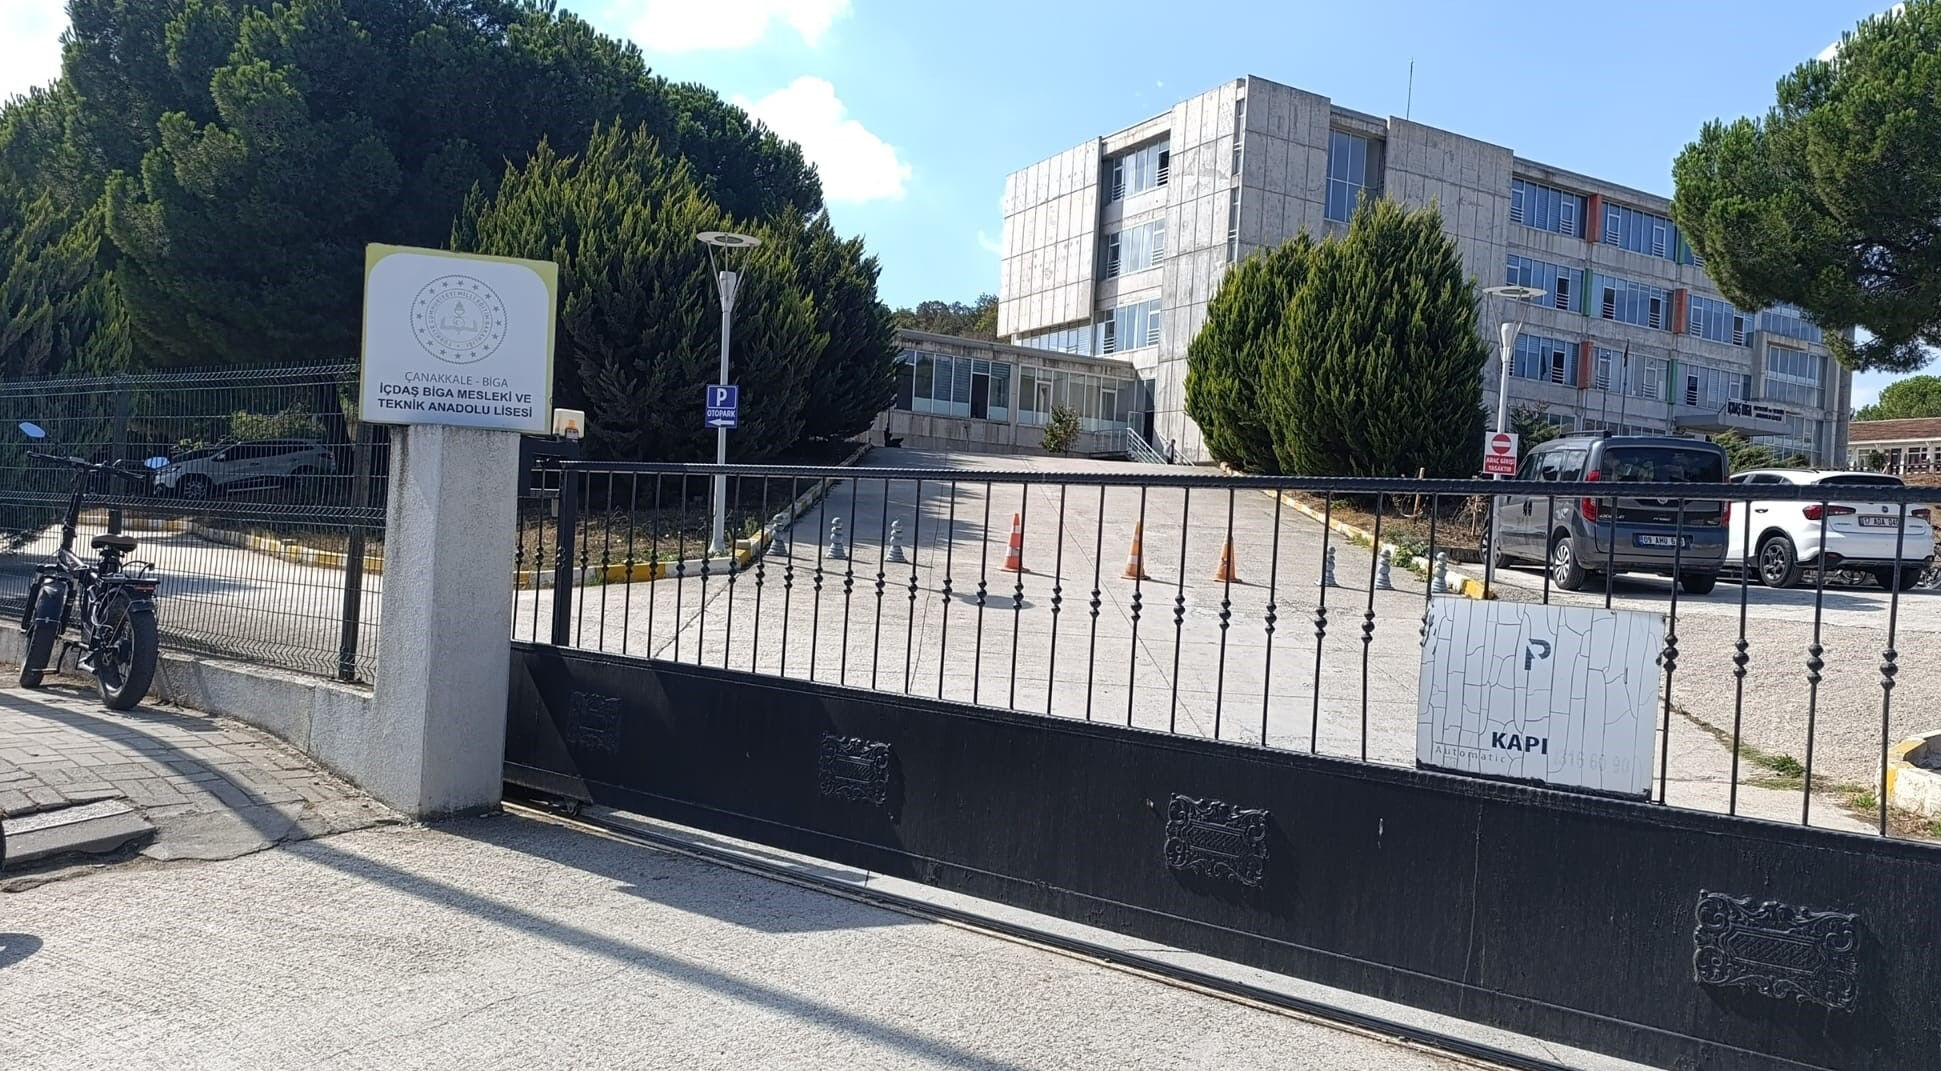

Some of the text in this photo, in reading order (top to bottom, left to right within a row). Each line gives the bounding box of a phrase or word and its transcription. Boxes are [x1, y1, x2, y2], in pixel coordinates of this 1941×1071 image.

[404, 371, 473, 386] ÇANAKKALE
[482, 376, 509, 388] BİGA
[379, 382, 532, 404] İÇDAŞ BİGA MESLEKİ VE
[716, 387, 728, 407] P
[377, 398, 533, 418] TEKNİK ANADOLU LİSESİ
[706, 409, 736, 418] OTOPARK
[1491, 731, 1548, 755] KAPI
[1435, 744, 1507, 764] Automatic
